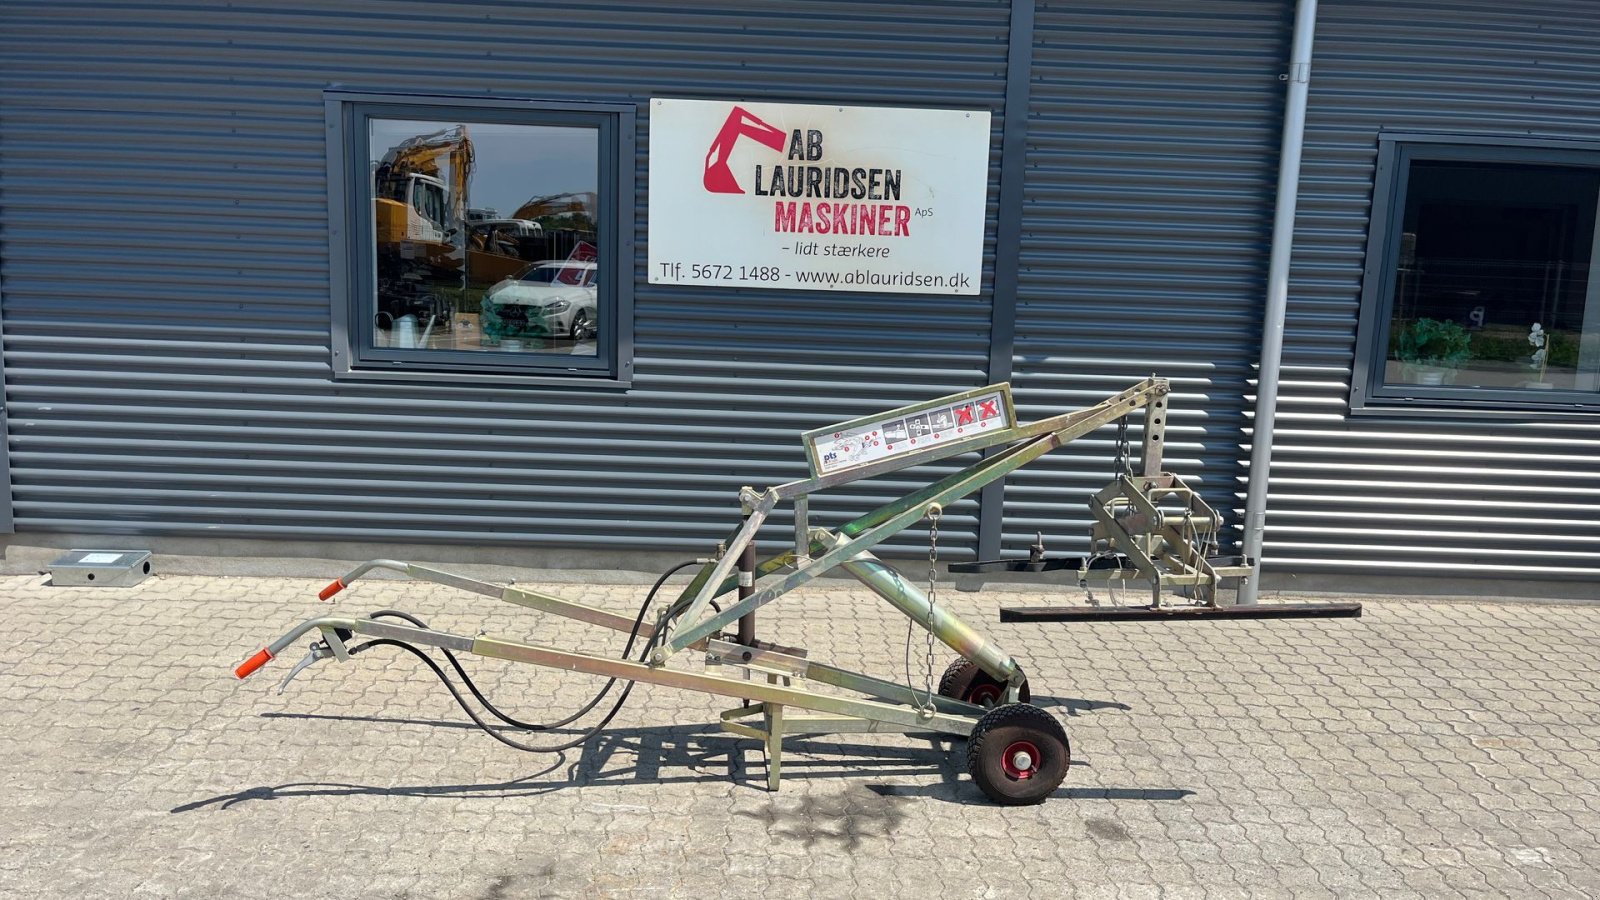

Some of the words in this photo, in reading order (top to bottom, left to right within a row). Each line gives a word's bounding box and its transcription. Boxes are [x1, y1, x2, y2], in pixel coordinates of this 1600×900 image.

[788, 129, 823, 161] AB
[755, 165, 902, 200] LAURIDSEN
[774, 201, 911, 236] MASKINER
[914, 207, 934, 218] ApS
[795, 241, 818, 256] lidt
[824, 243, 890, 259] stærkere
[660, 262, 685, 281] Tlf.
[691, 264, 733, 280] 5672
[739, 266, 780, 281] 1488
[796, 269, 970, 288] www.ablauridsen.dk
